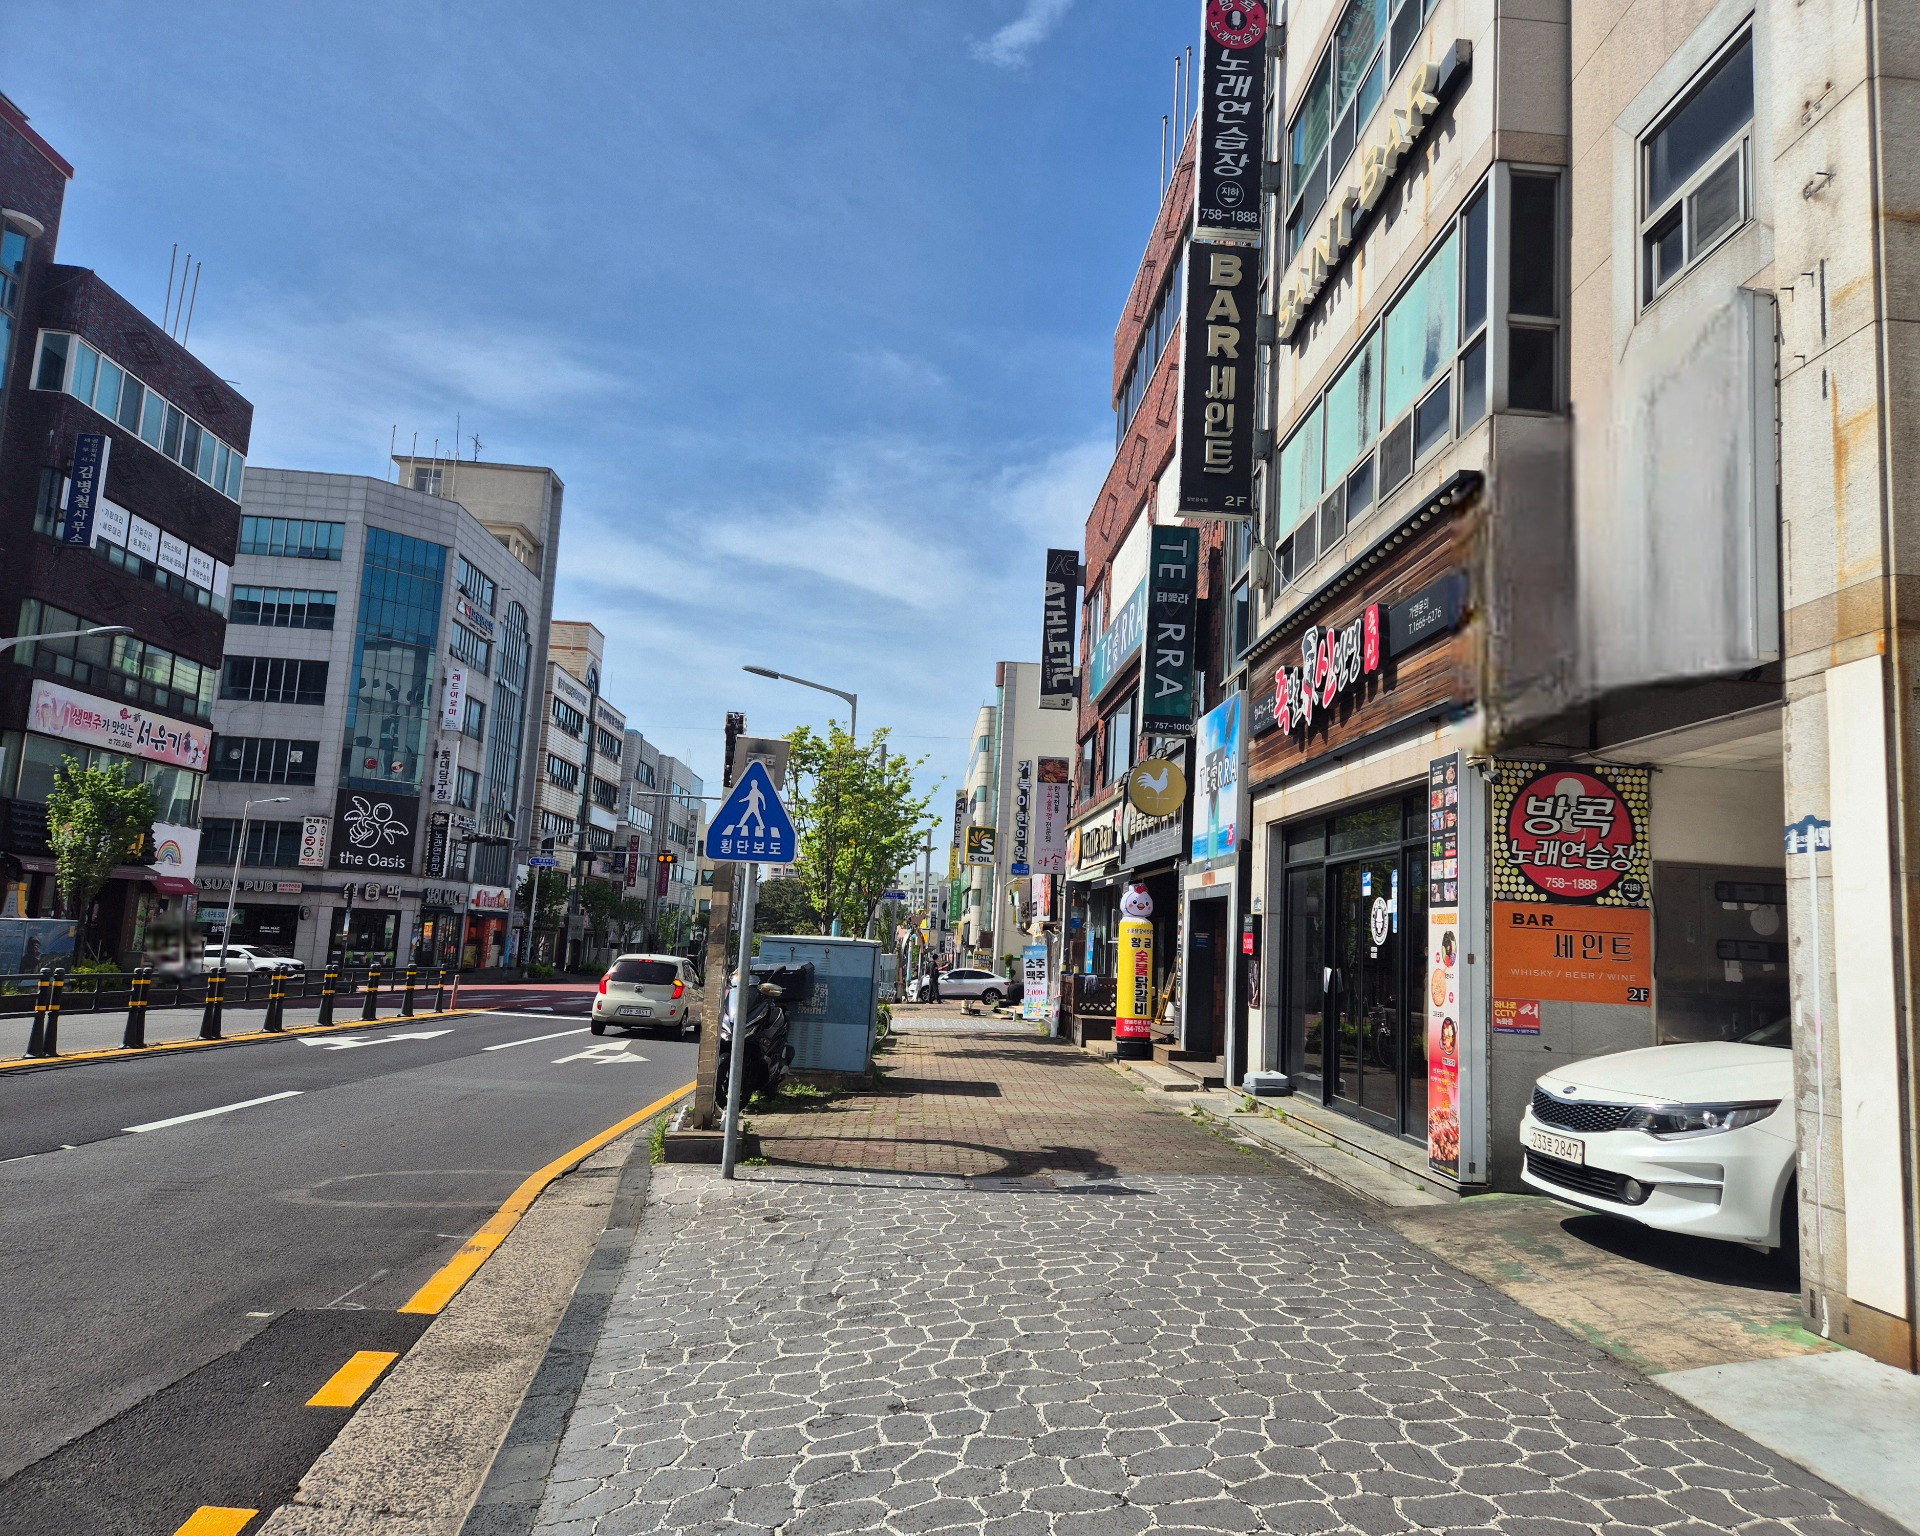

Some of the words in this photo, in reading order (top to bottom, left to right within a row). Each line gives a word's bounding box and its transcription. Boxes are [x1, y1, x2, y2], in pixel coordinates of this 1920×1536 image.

[1210, 21, 1261, 46] 노래연습장
[1213, 49, 1253, 177] 노래연습장
[1360, 61, 1440, 211] BAR
[1221, 187, 1239, 197] 지하
[1201, 208, 1258, 223] 758-1888
[1205, 253, 1243, 359] BAR
[69, 465, 94, 543] 김병철사무소
[1224, 495, 1247, 507] 2F
[1045, 580, 1074, 688] ATHLETIC
[72, 708, 110, 732] 생맥주가
[112, 720, 135, 738] 맛있는
[137, 720, 183, 755] 서유기
[1014, 760, 1032, 862] 거북이한의원
[1523, 794, 1615, 839] 방콕
[720, 838, 782, 855] 횡단보도
[340, 851, 363, 866] the
[367, 853, 406, 868] Oasis
[969, 855, 992, 863] S-OIL
[1508, 839, 1637, 872] 노래연습장
[244, 880, 274, 892] PUB
[1545, 877, 1598, 890] 758-1888
[1624, 883, 1641, 893] 지하
[443, 890, 458, 905] MAC
[1512, 913, 1554, 926] BAR
[1130, 937, 1152, 949] 황금
[1552, 933, 1633, 962] 세인트
[1026, 958, 1046, 969] 소주
[1026, 970, 1046, 981] 맥주
[1511, 968, 1553, 977] WHISKY
[1565, 971, 1595, 980] BEER
[1607, 973, 1637, 982] WINE
[1627, 988, 1649, 1002] 2F
[1494, 1001, 1517, 1009] 하나로
[1494, 1009, 1517, 1017] CCTV
[1554, 1138, 1579, 1160] 2847
